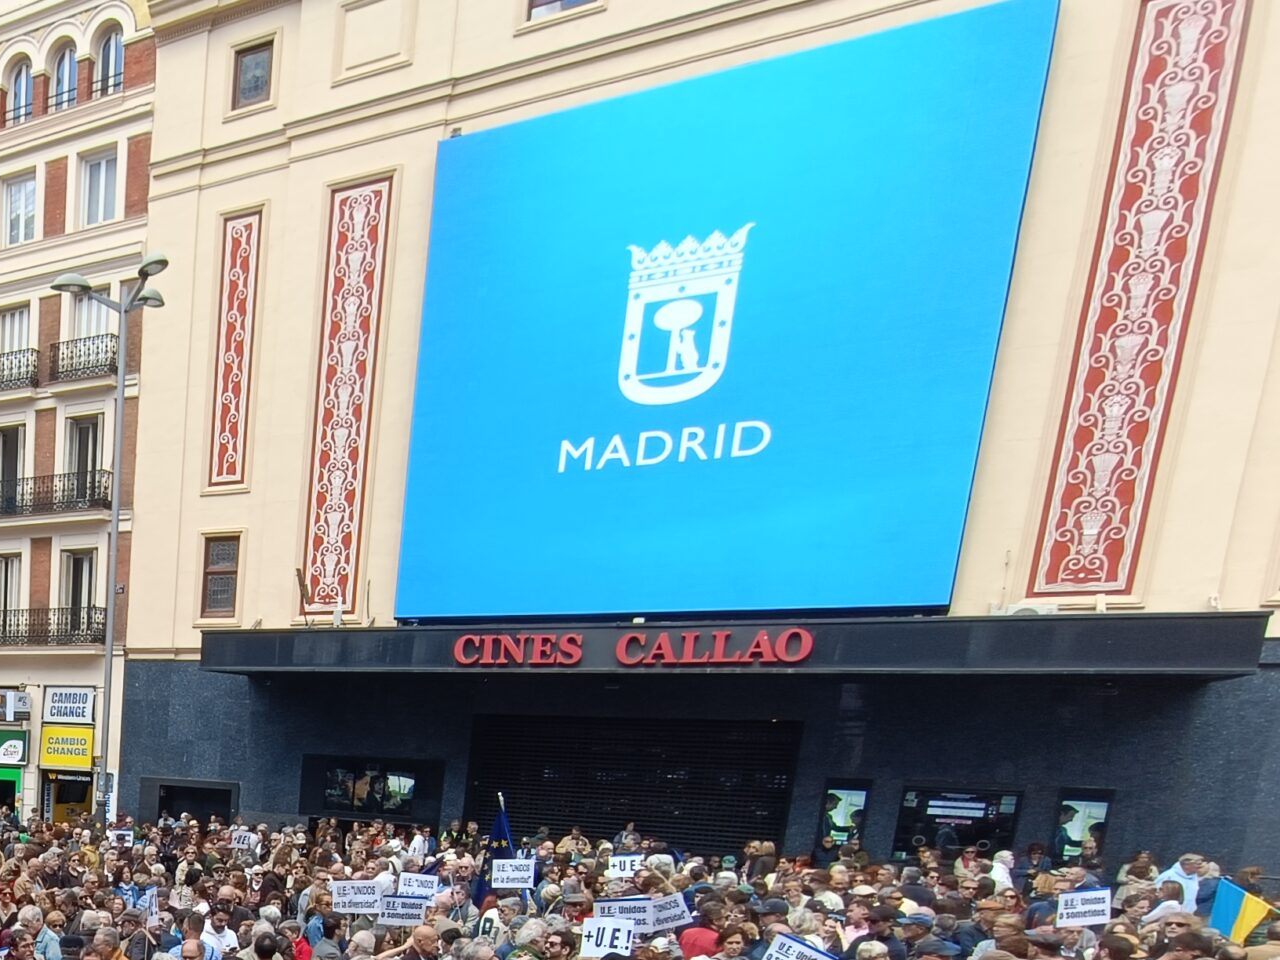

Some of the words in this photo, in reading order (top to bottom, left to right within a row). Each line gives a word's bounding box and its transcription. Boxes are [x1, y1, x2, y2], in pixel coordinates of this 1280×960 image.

[558, 420, 772, 474] MADRID
[453, 633, 583, 665] CINES
[615, 628, 814, 665] CALLAO
[51, 692, 89, 705] CAMBIO
[49, 705, 87, 718] CHANGE
[47, 736, 87, 746] CAMBIO
[46, 746, 88, 757] CHANGE
[618, 905, 647, 914] Unidos
